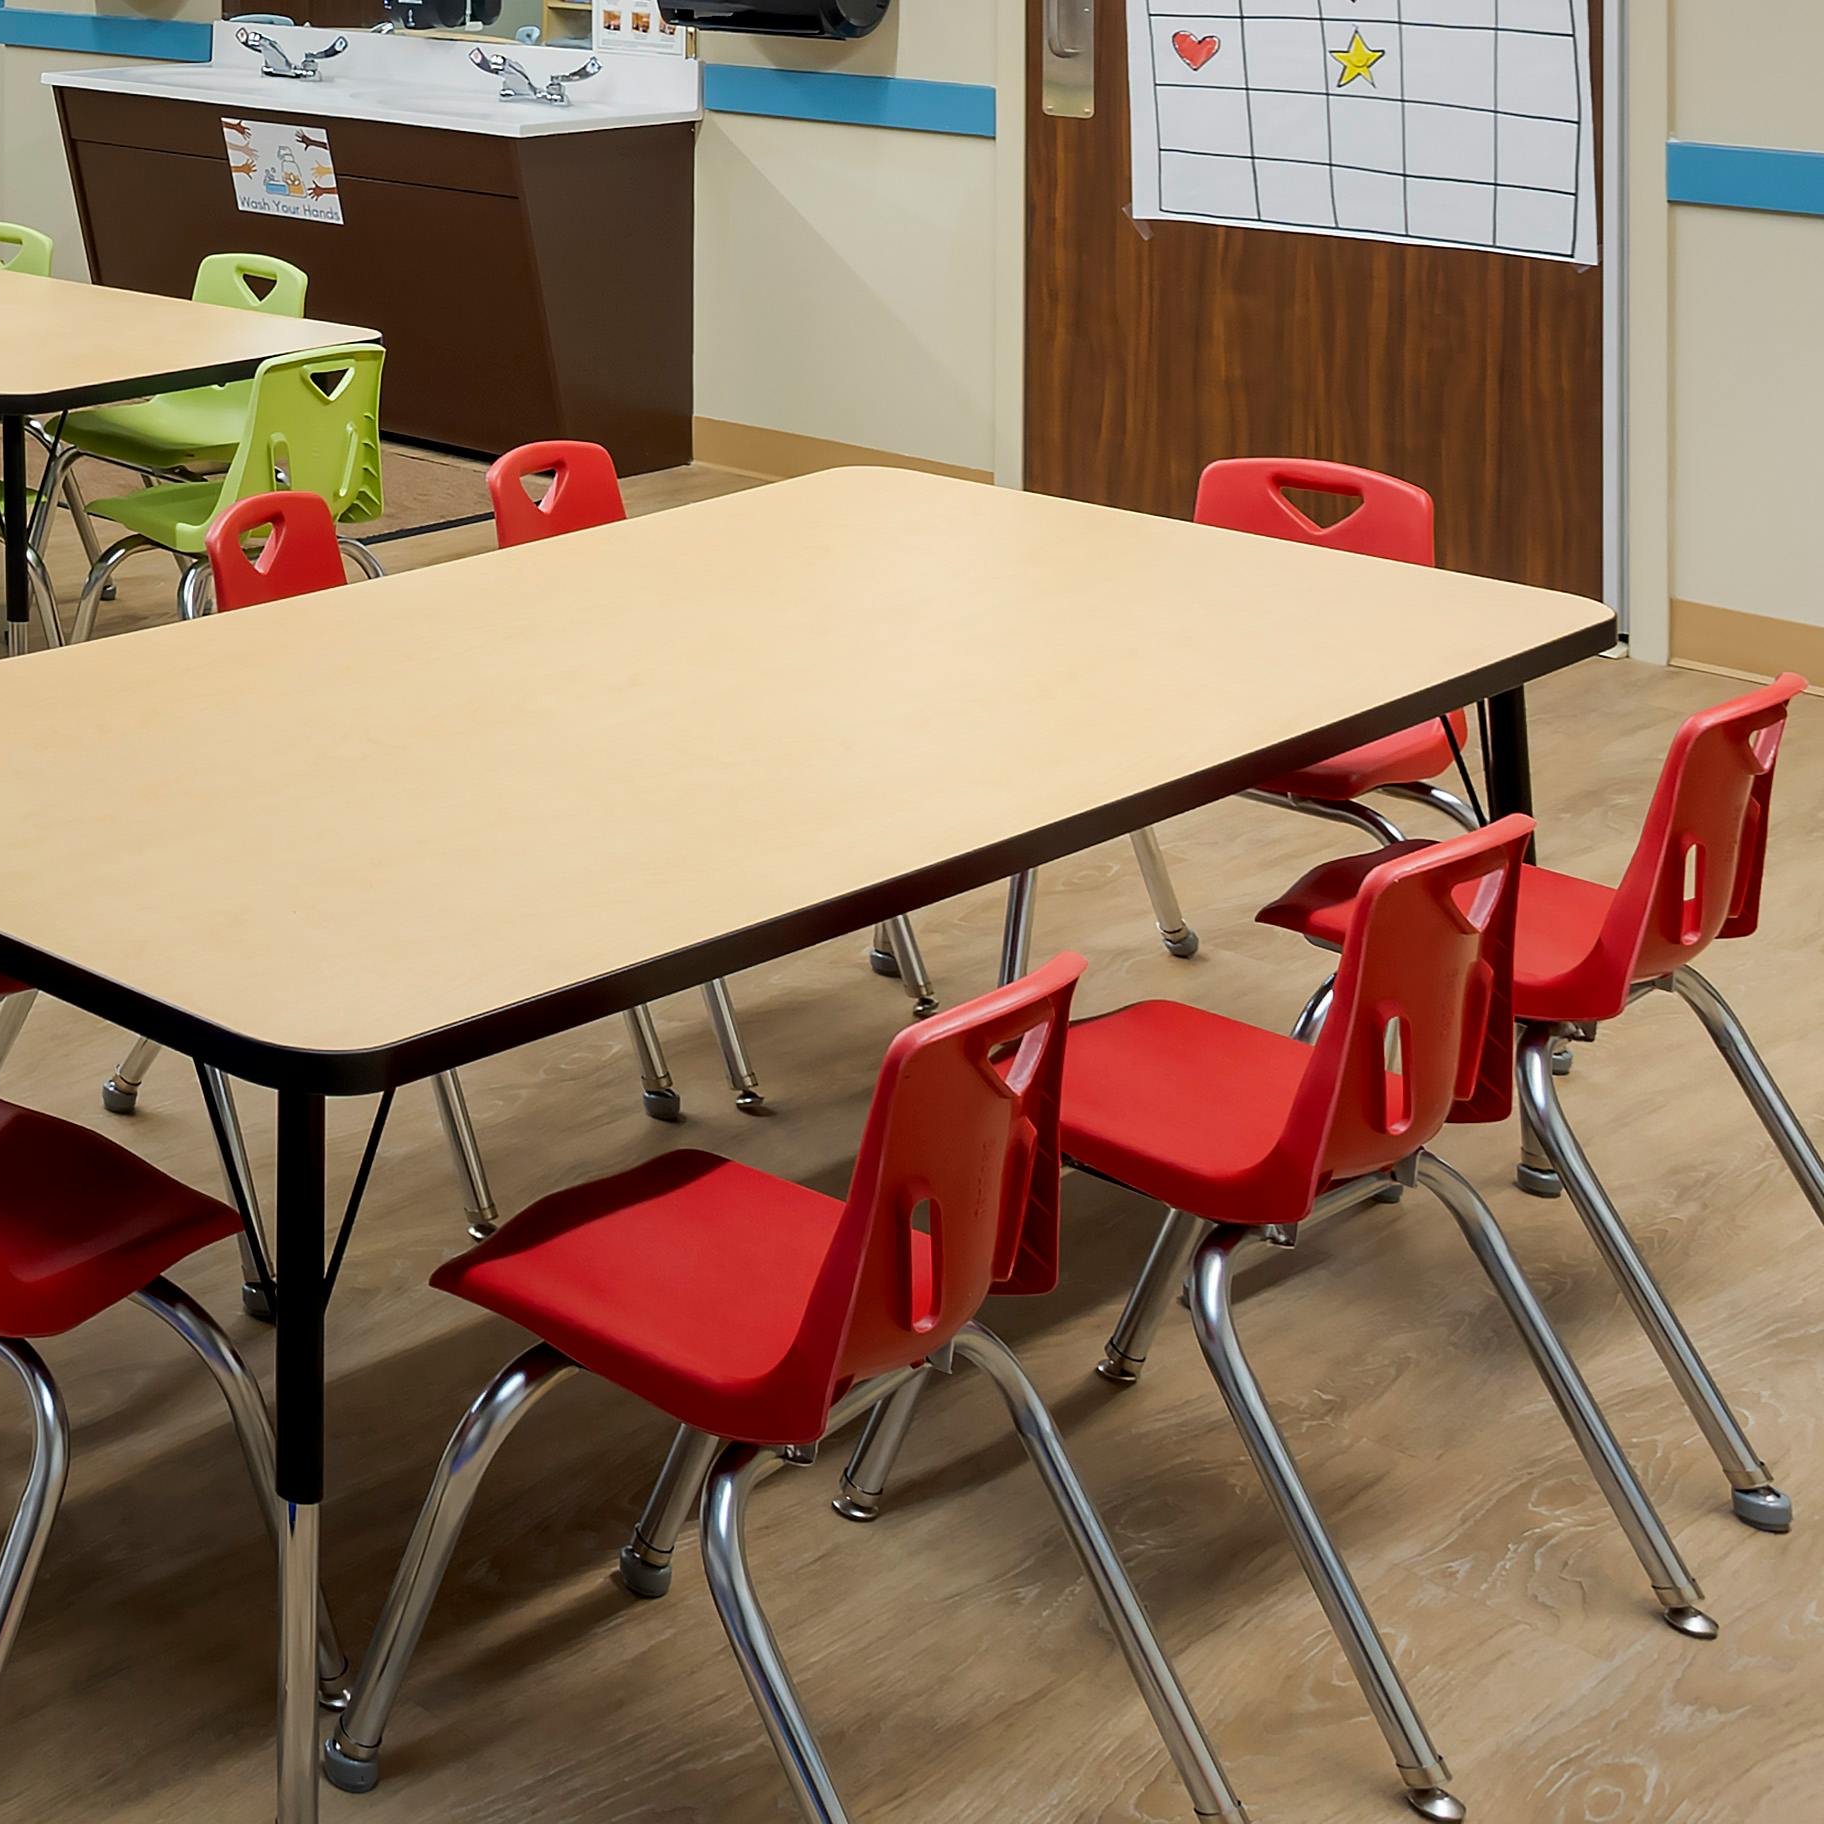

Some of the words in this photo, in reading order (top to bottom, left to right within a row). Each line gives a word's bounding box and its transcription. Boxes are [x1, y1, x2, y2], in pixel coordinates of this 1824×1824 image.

[239, 195, 271, 211] Wash
[272, 198, 300, 216] Your
[303, 205, 341, 222] Hands
